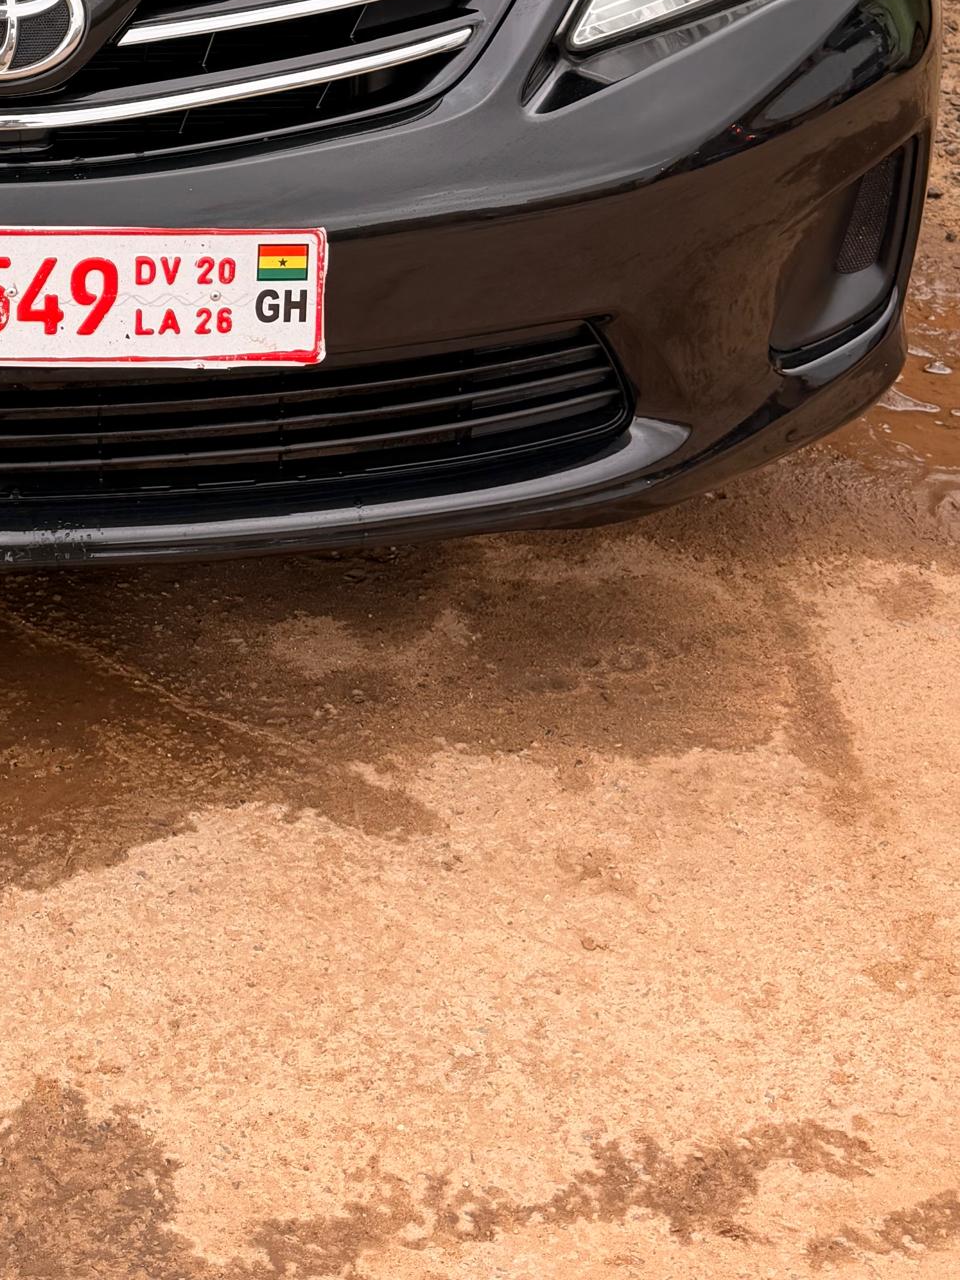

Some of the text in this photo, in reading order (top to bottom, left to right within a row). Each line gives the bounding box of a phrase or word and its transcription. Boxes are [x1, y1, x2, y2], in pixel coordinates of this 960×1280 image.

[135, 256, 236, 285] DV 20
[255, 289, 307, 323] GH
[134, 307, 233, 335] LA 26
